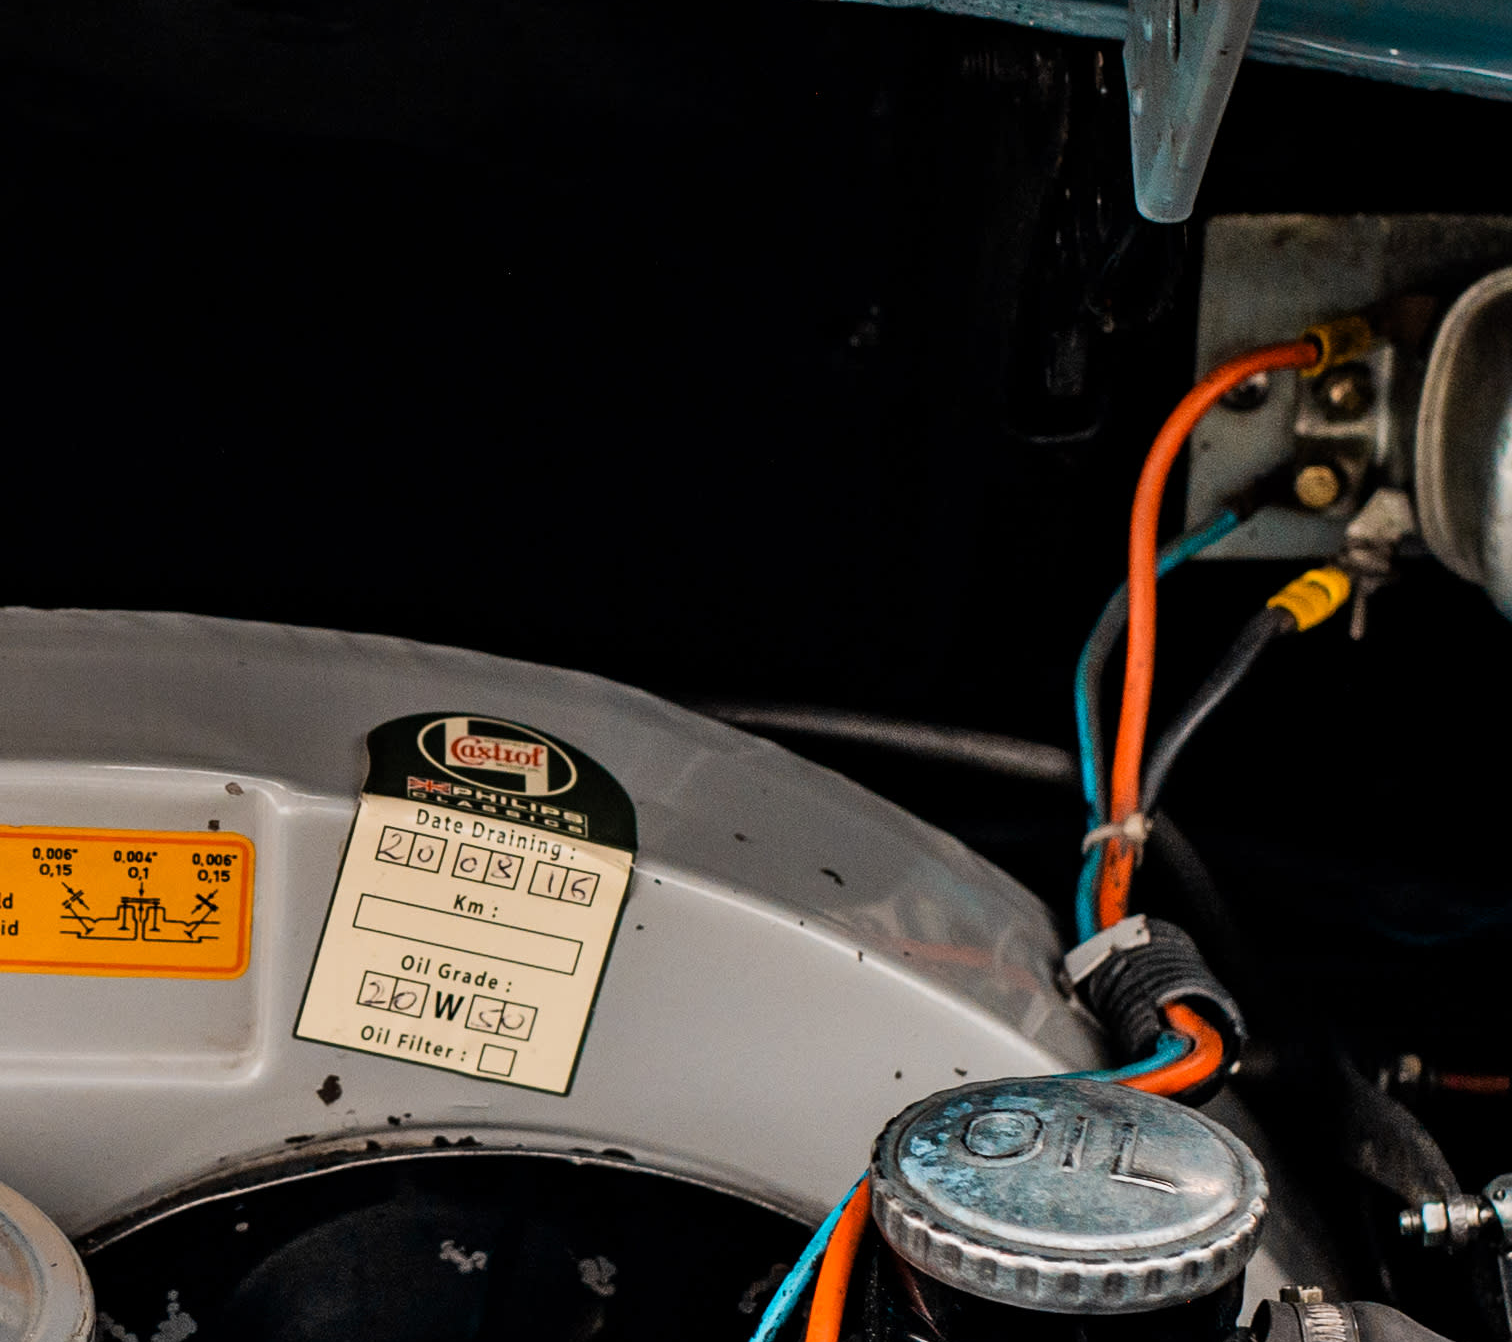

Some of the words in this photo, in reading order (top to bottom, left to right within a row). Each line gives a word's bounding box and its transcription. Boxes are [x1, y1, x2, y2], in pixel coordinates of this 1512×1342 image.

[450, 735, 545, 768] Castrol
[452, 785, 585, 825] PHILIPS
[377, 832, 435, 862] 20
[416, 808, 464, 834] Date
[471, 820, 562, 861] Draining
[453, 894, 484, 916] Km
[401, 955, 429, 975] Oil
[438, 963, 499, 990] Grade
[434, 990, 465, 1021] W
[360, 1025, 388, 1045] Oil
[397, 1034, 454, 1061] Filter
[961, 1108, 1178, 1196] OIL
